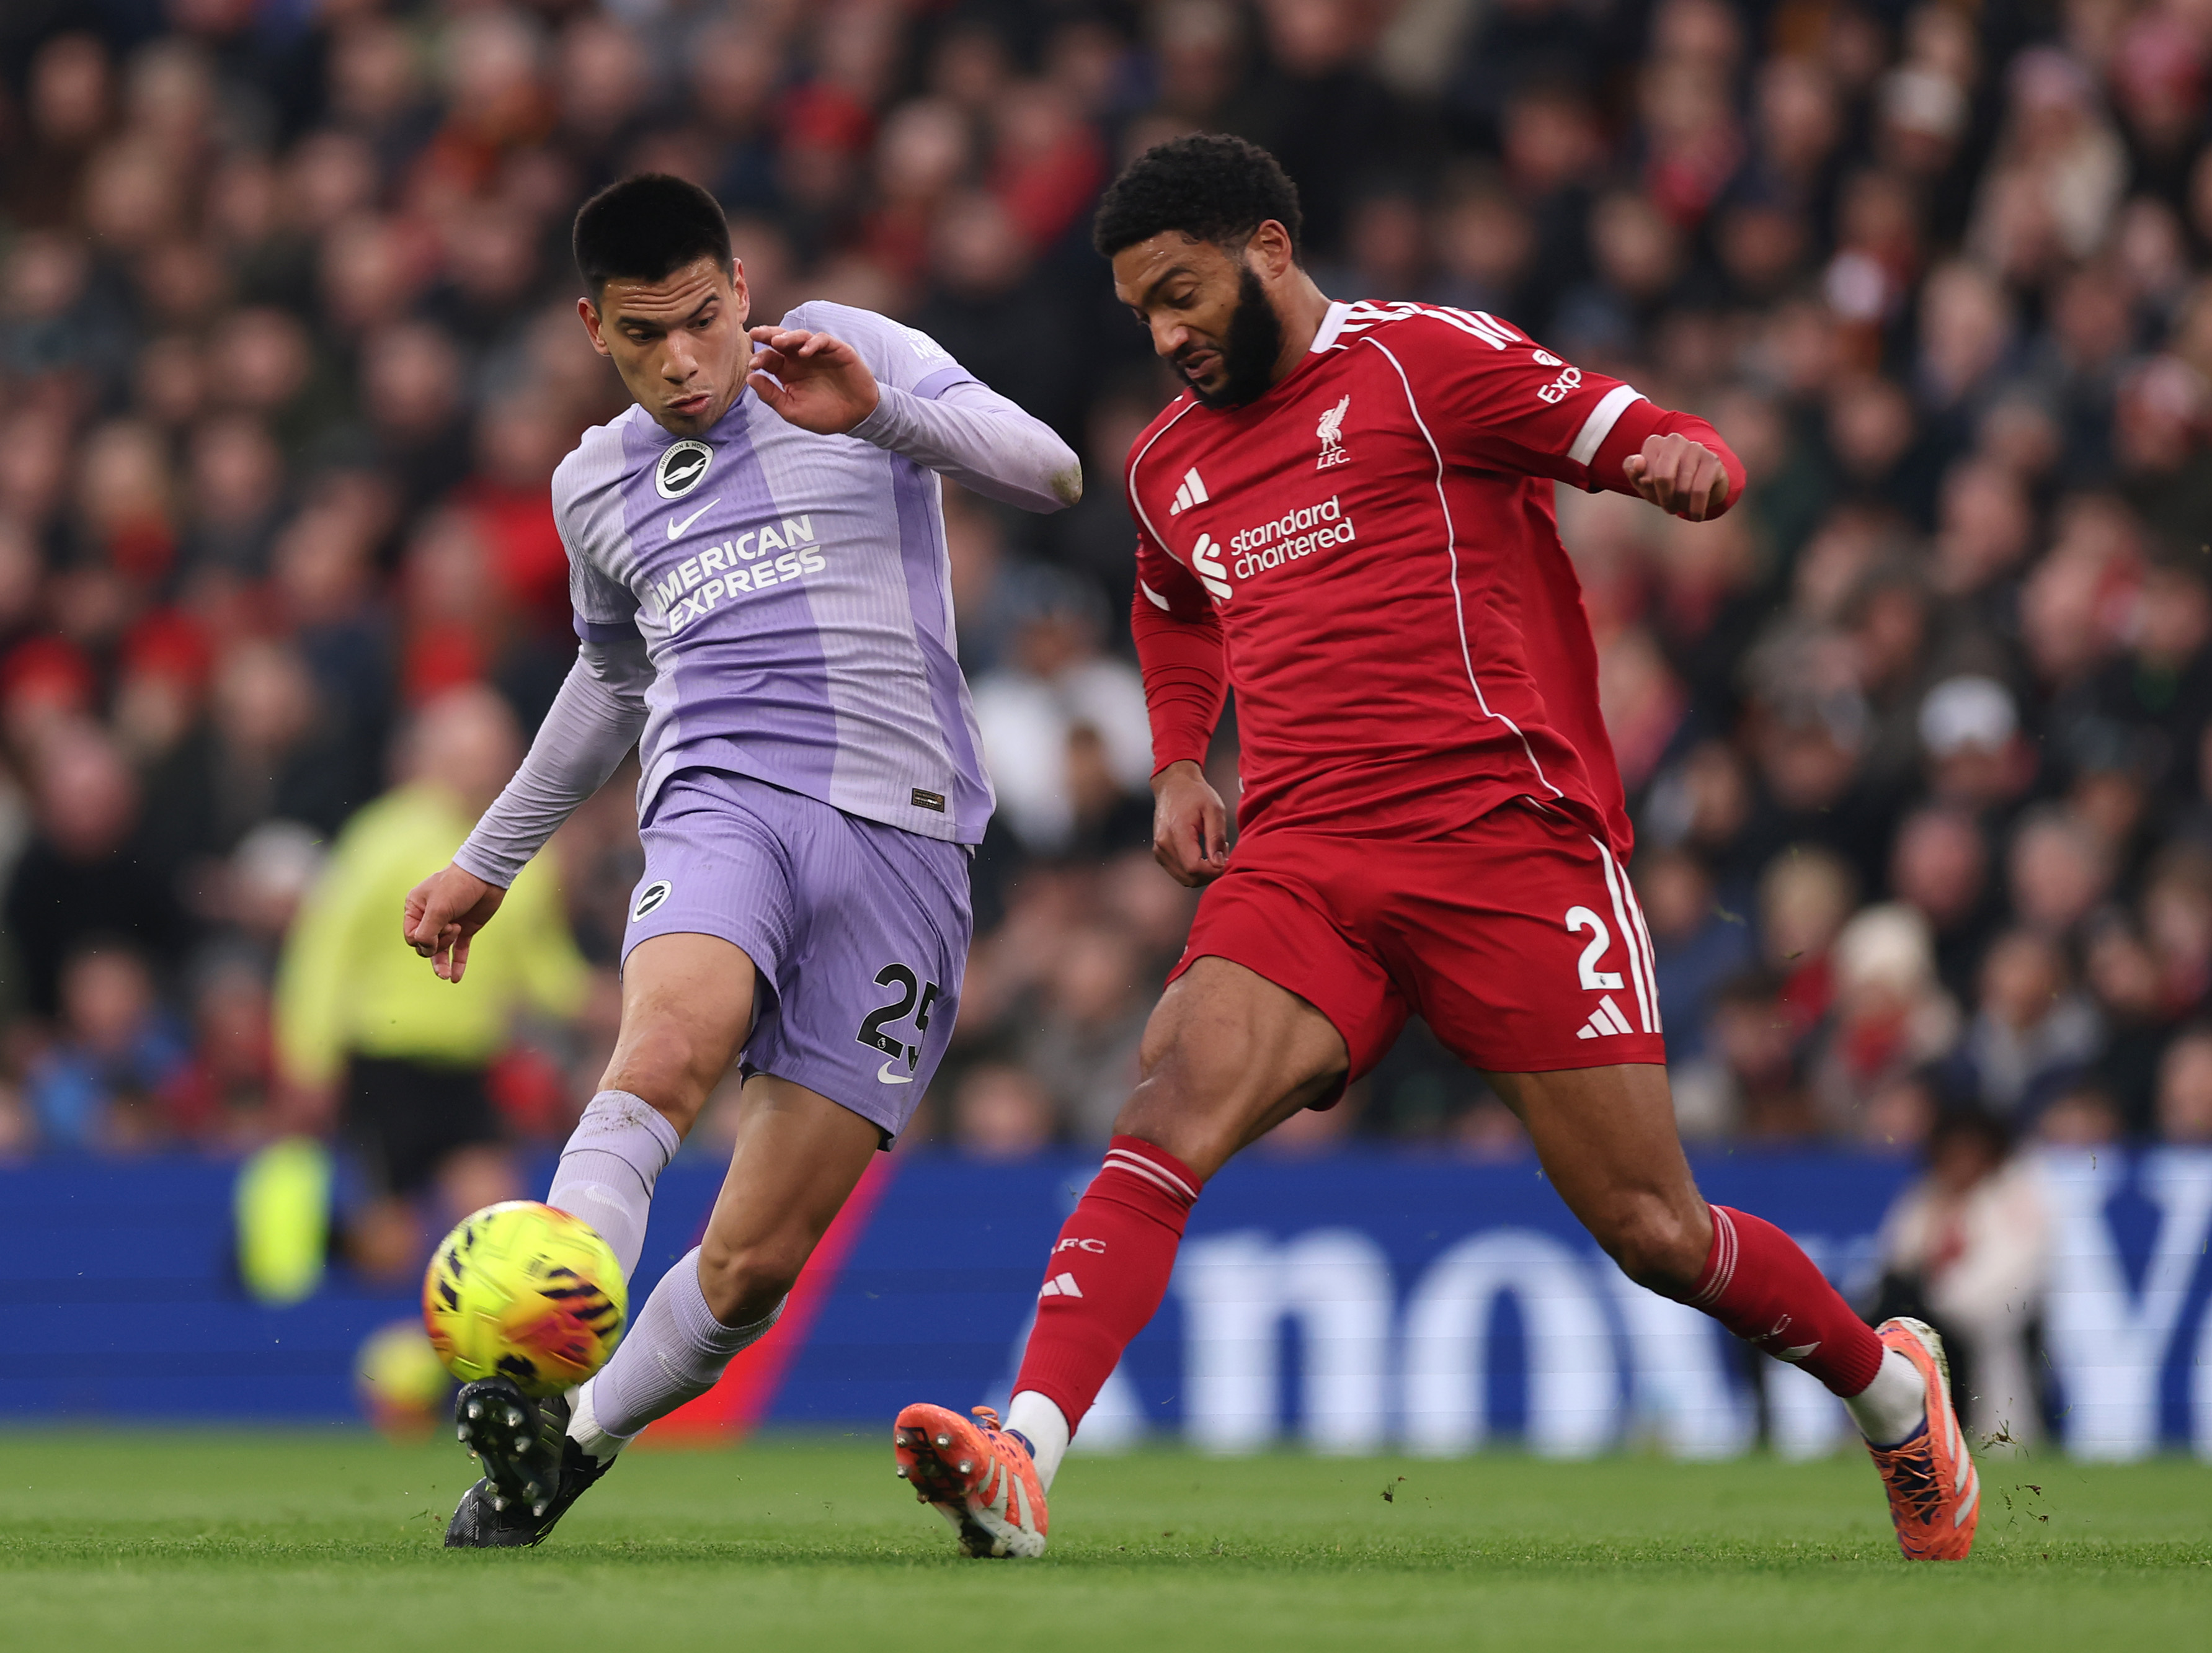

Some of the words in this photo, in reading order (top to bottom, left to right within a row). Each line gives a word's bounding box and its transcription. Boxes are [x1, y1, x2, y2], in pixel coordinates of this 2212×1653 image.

[1537, 367, 1582, 404] Exp
[660, 443, 683, 469] BRIGHTON
[691, 442, 708, 453] HOVE
[1230, 495, 1341, 556] standard
[1235, 517, 1356, 579] chartered
[668, 545, 826, 635] EXPRESS
[1565, 906, 1625, 990] 2
[1051, 1238, 1106, 1254] FC
